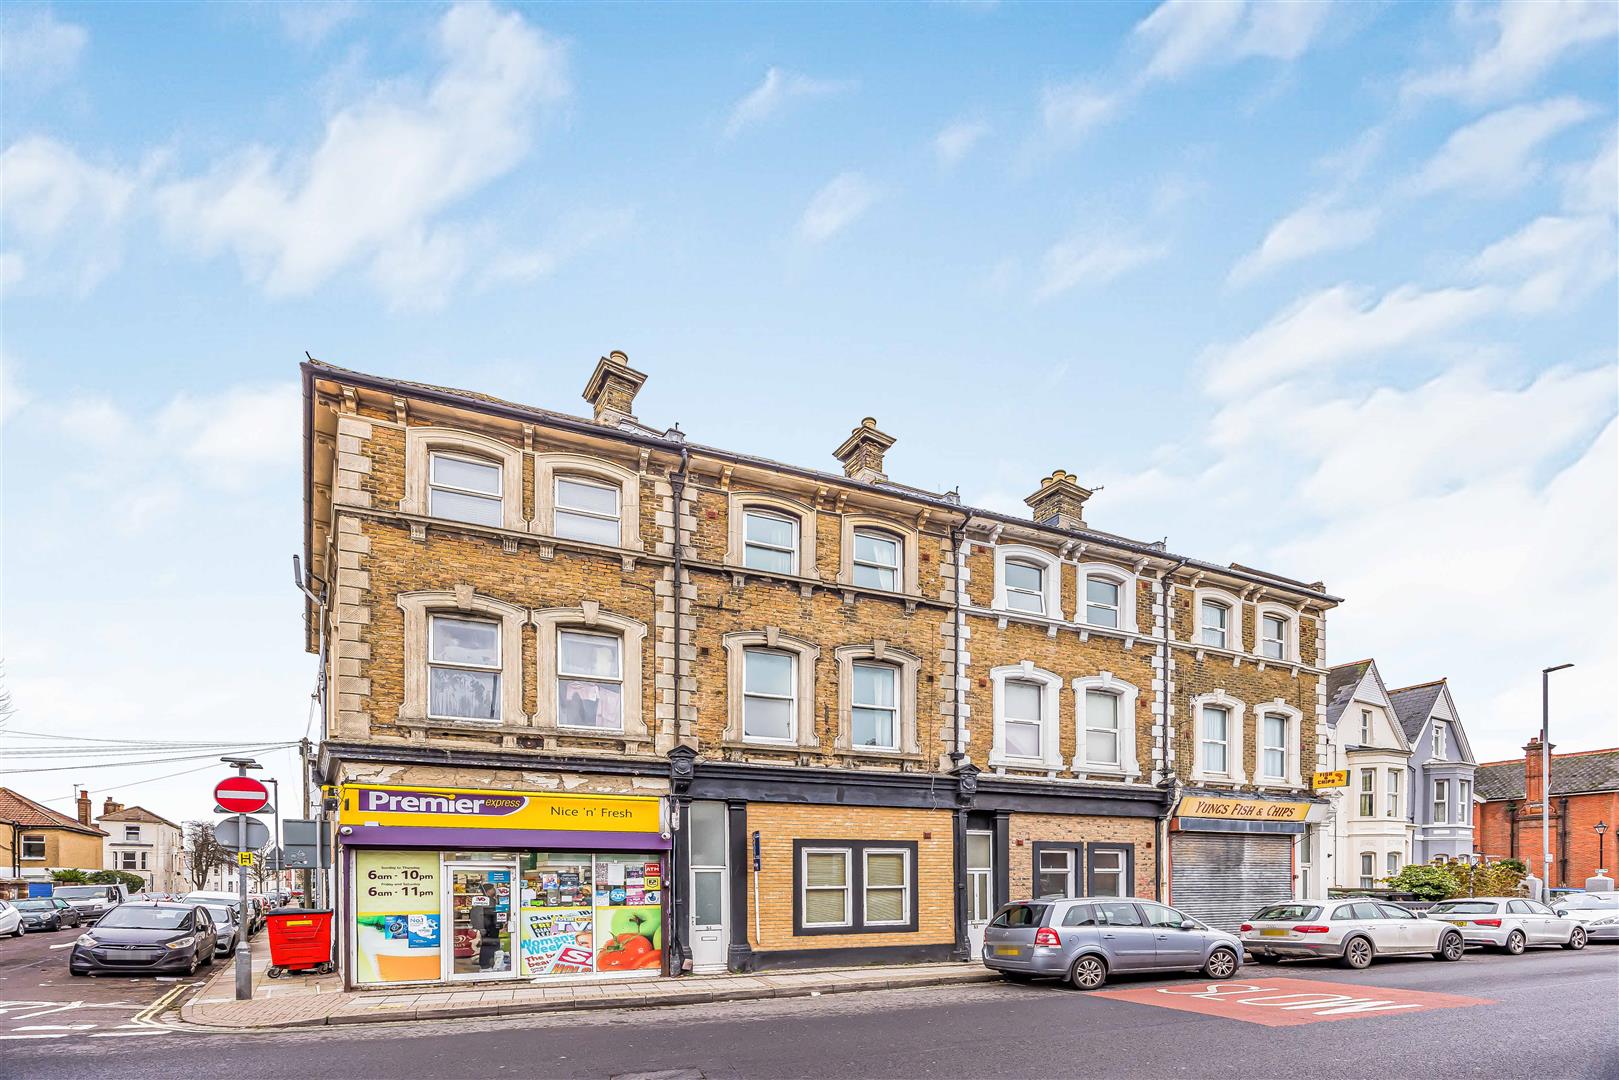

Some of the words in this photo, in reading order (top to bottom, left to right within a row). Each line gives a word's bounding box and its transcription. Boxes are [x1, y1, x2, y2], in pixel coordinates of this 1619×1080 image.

[368, 791, 485, 814] Premier
[485, 798, 521, 808] express
[1195, 801, 1230, 815] YUNGS
[1231, 803, 1256, 816] FISH
[1256, 808, 1264, 816] &
[1266, 805, 1296, 817] CHIPS
[550, 806, 579, 816] Nice
[601, 808, 633, 818] Fresh
[241, 853, 251, 864] H
[368, 870, 392, 880] 6am
[401, 870, 434, 881] 10pm
[368, 887, 392, 897] 6am
[401, 887, 434, 897] 11pm
[520, 934, 576, 948] Woman's
[1156, 984, 1424, 1016] SLOW
